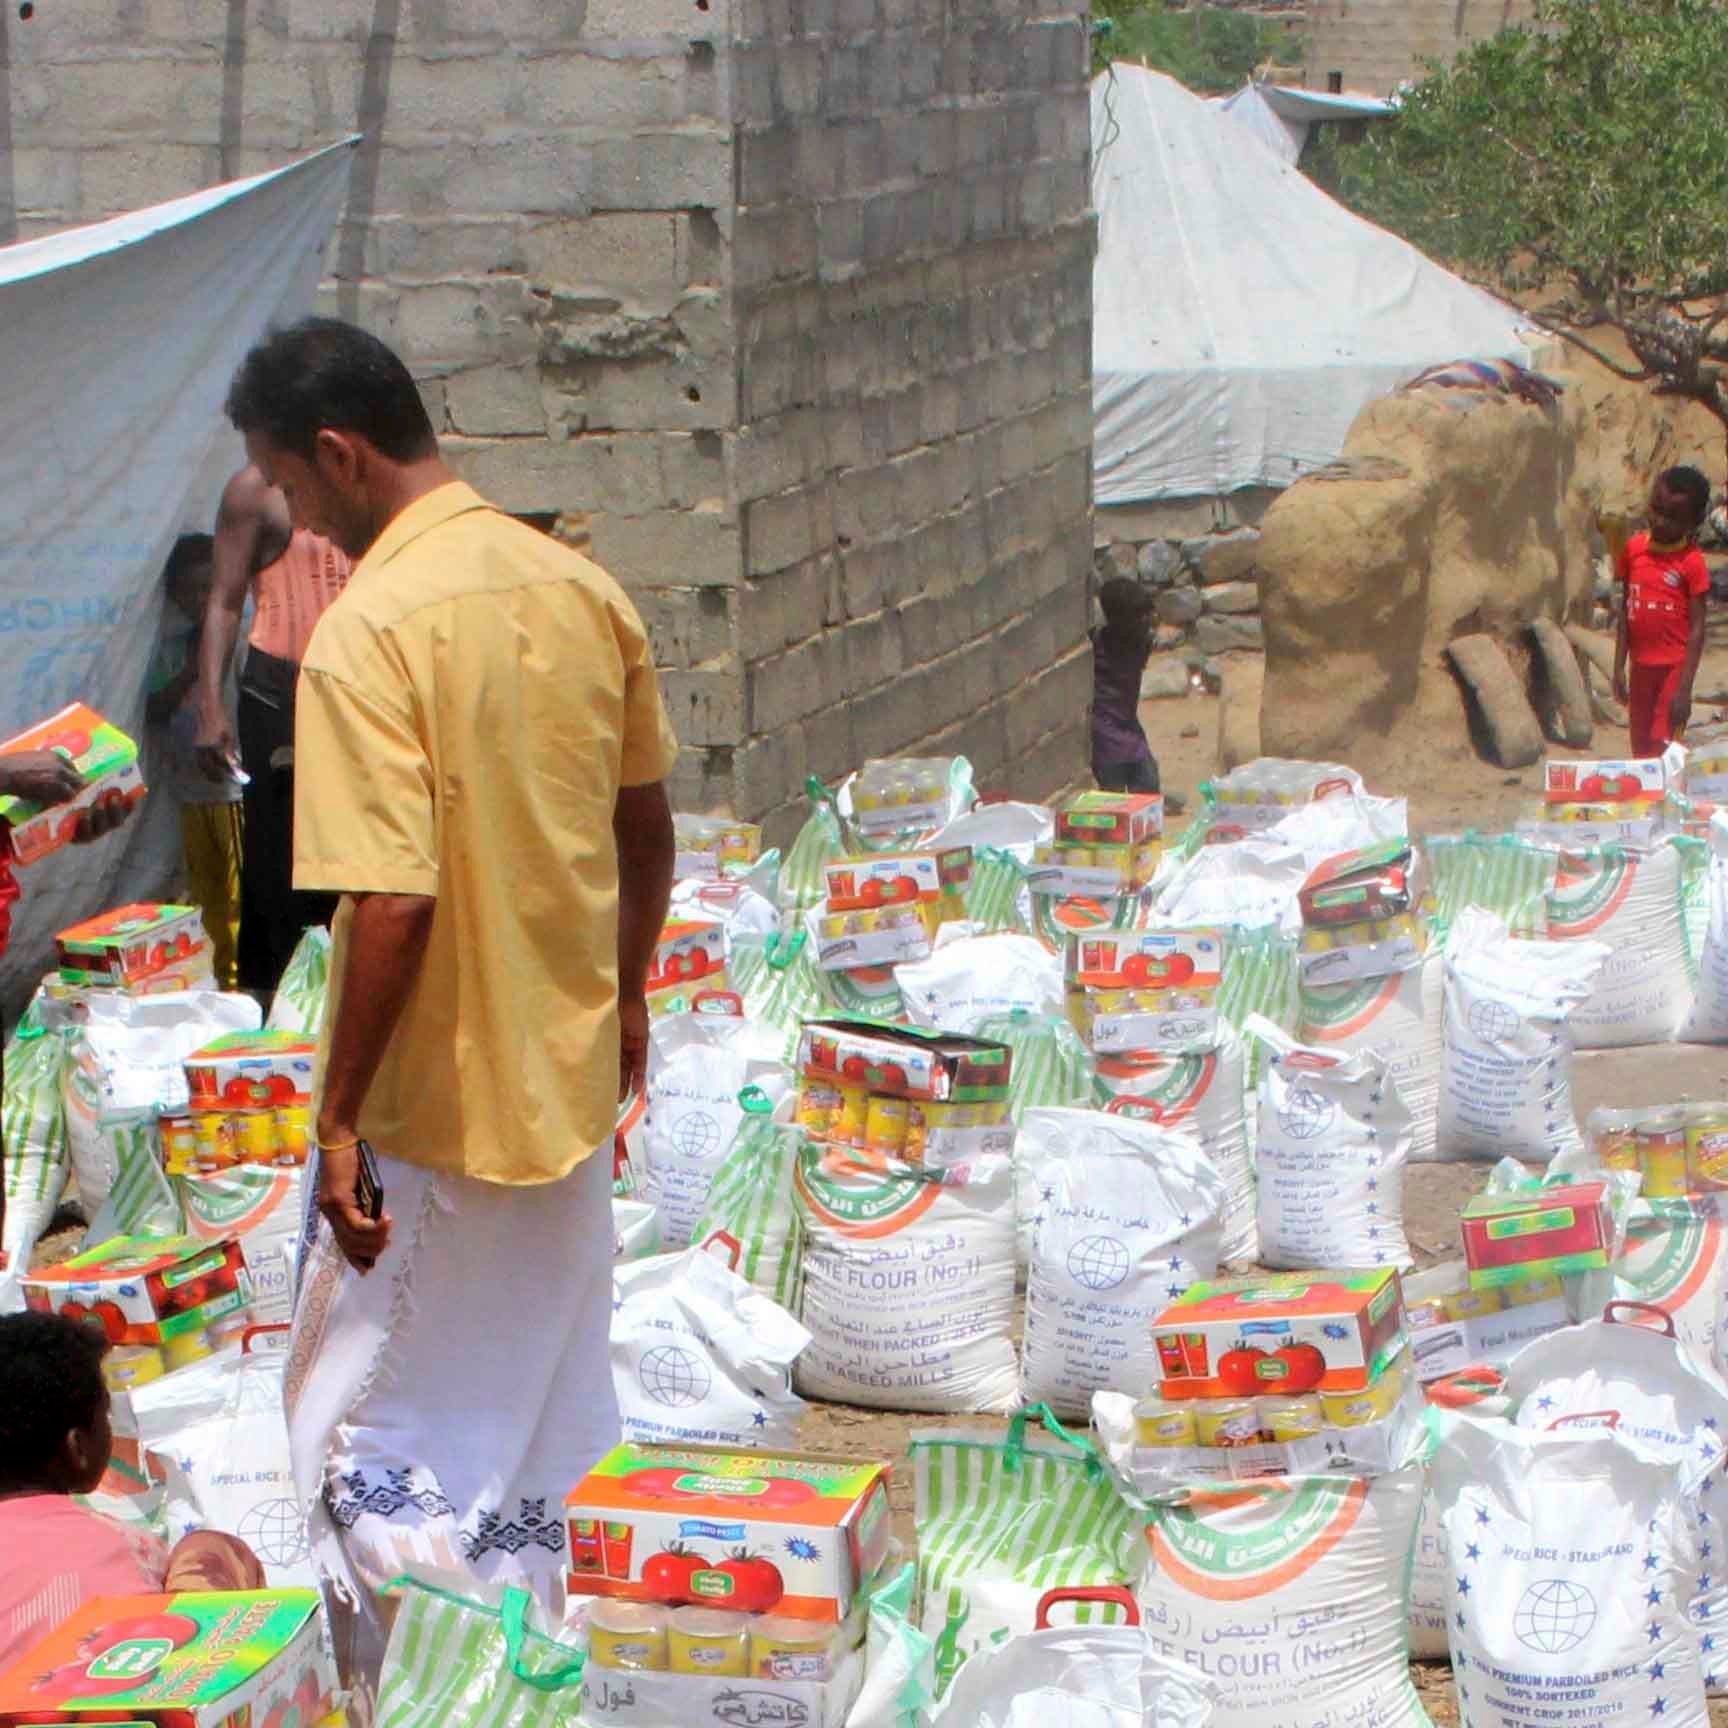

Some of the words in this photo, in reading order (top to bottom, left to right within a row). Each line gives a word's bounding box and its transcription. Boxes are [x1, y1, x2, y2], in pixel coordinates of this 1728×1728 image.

[847, 1268, 918, 1290] FLOUR
[883, 1334, 941, 1352] PACKED
[825, 1360, 893, 1389] RASEED
[897, 1367, 954, 1388] MILLS
[254, 1471, 280, 1484] RICE
[1183, 1648, 1282, 1678] FLOUR
[1492, 1669, 1542, 1687] PREMIUM
[595, 1681, 636, 1712] فول
[746, 1700, 808, 1724] كاتش
